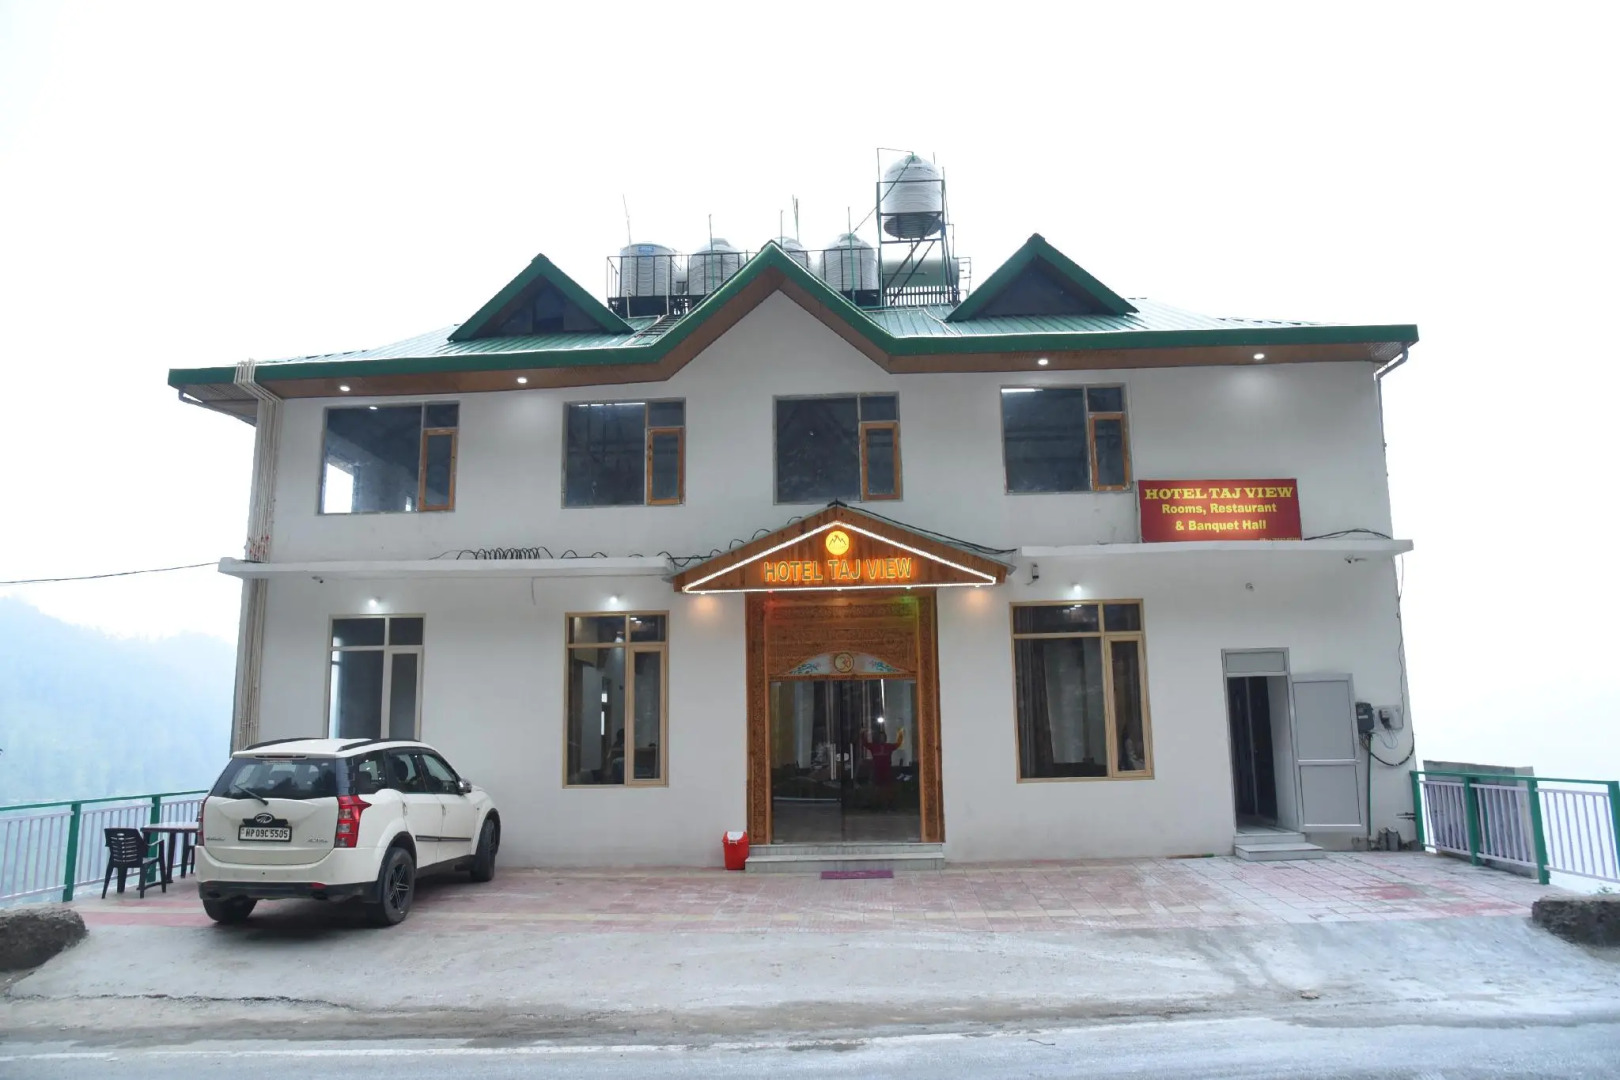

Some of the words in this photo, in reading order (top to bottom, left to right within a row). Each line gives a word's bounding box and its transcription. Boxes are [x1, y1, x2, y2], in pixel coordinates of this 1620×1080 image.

[1144, 488, 1207, 500] HOTEL
[1209, 487, 1242, 499] TAJ
[1243, 487, 1293, 499] VIEW
[1162, 503, 1207, 515] Rooms,
[1210, 502, 1277, 514] Restaurant
[1175, 520, 1185, 531] &
[1188, 520, 1239, 532] Banquet
[1242, 520, 1267, 530] Hall
[764, 560, 823, 582] HOTEL
[828, 559, 861, 580] TAJ
[866, 558, 912, 579] VIEW
